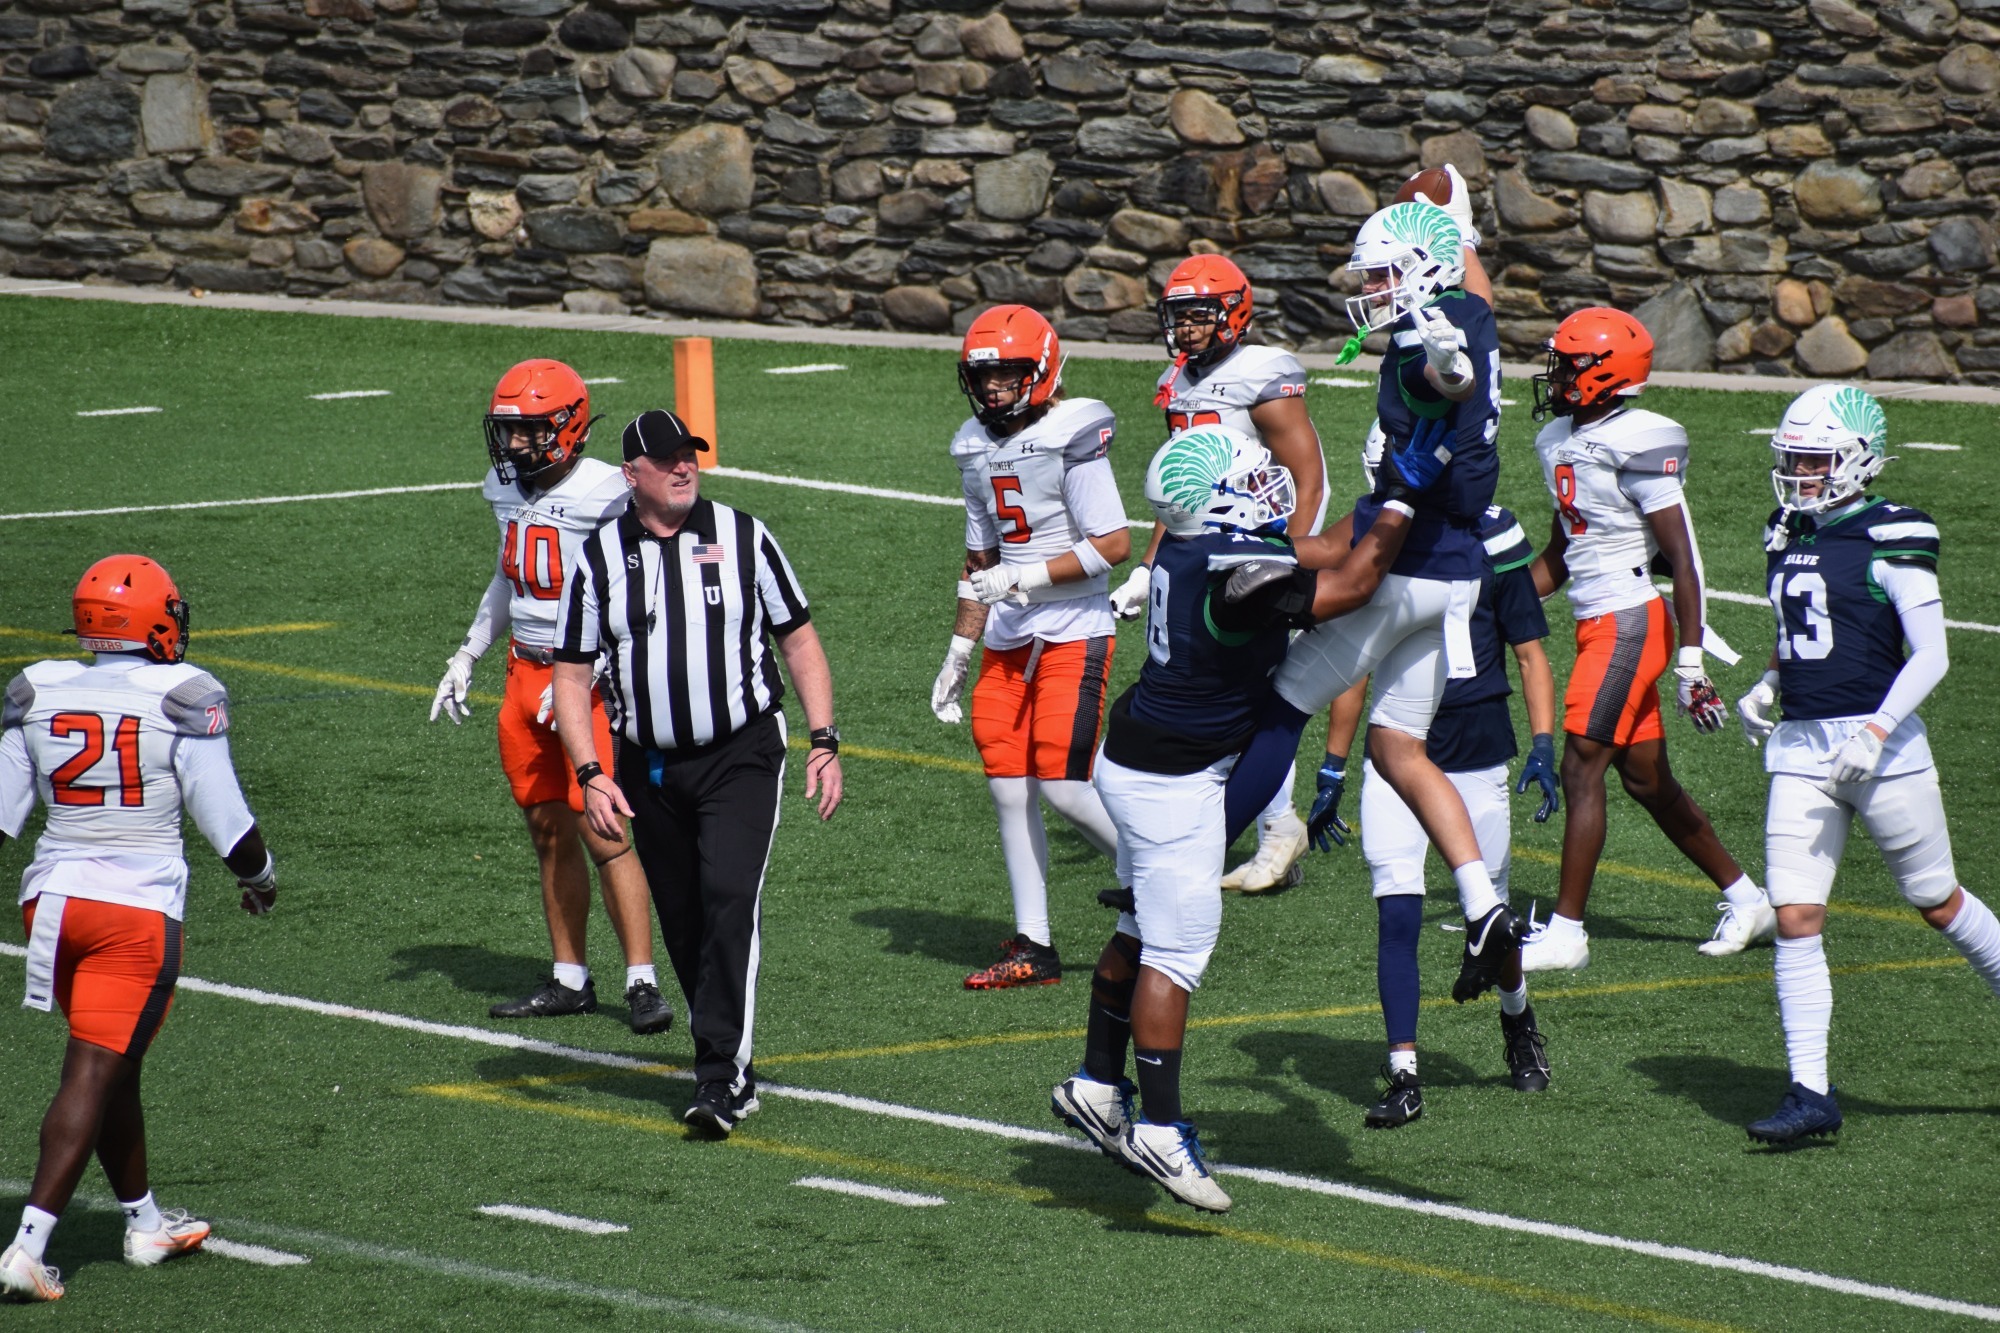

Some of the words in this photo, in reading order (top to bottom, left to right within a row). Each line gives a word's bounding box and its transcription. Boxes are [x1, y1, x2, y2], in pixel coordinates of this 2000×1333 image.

[988, 460, 1015, 471] PIONEERS
[1783, 433, 1804, 442] Riddell
[990, 475, 1030, 544] 5
[1555, 464, 1588, 535] 8
[502, 520, 565, 600] 40
[1784, 554, 1820, 566] SALVE
[705, 586, 721, 605] U
[1149, 564, 1171, 667] 8
[1770, 572, 1834, 660] 13
[50, 711, 145, 807] 21
